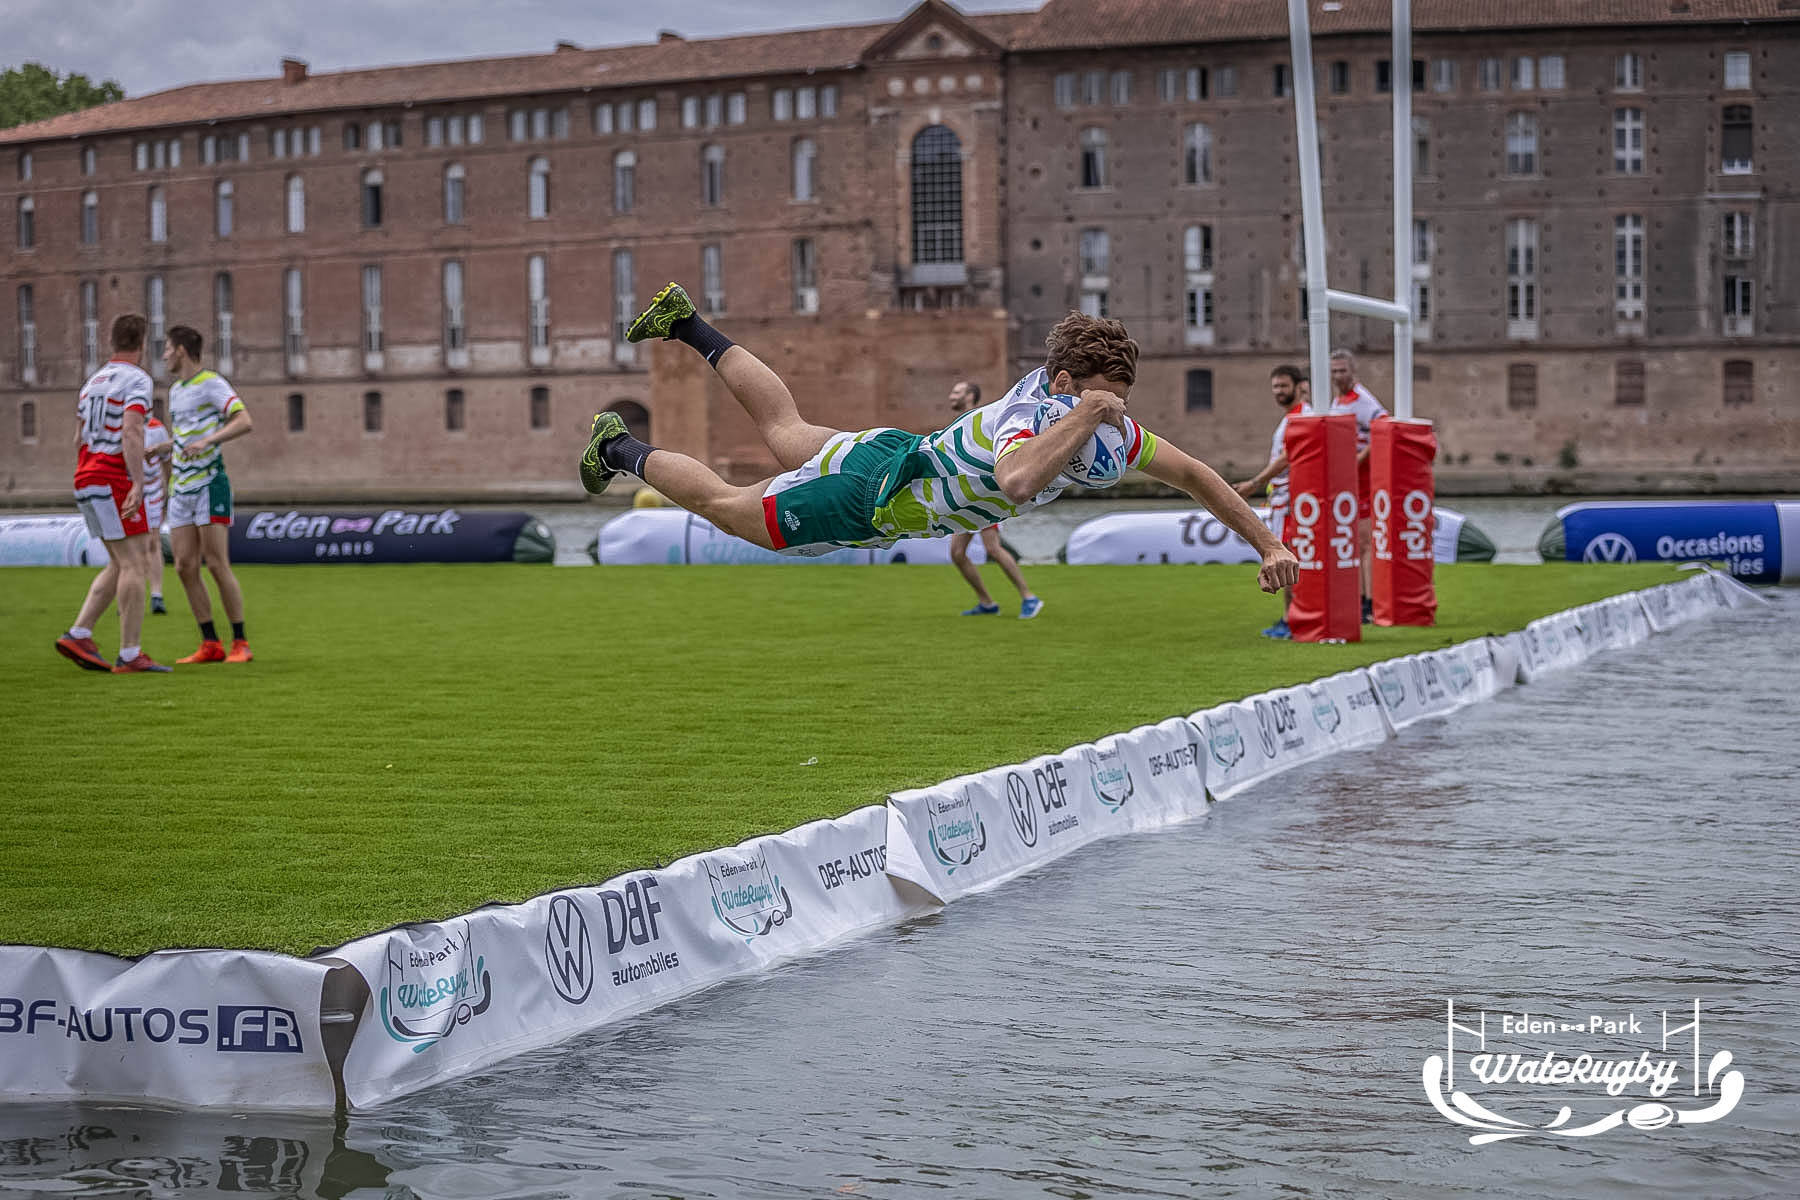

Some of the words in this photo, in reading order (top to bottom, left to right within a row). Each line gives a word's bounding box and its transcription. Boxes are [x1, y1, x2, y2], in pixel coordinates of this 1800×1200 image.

[246, 510, 331, 539] Eden
[372, 508, 461, 536] Park
[314, 540, 375, 557] PARIS
[1656, 532, 1765, 559] Occasions
[1032, 760, 1067, 814] DBF
[720, 862, 739, 878] Eden
[721, 879, 773, 910] WateRugby
[597, 876, 662, 955] DBF
[428, 937, 460, 966] Park
[611, 951, 680, 987] automobiles
